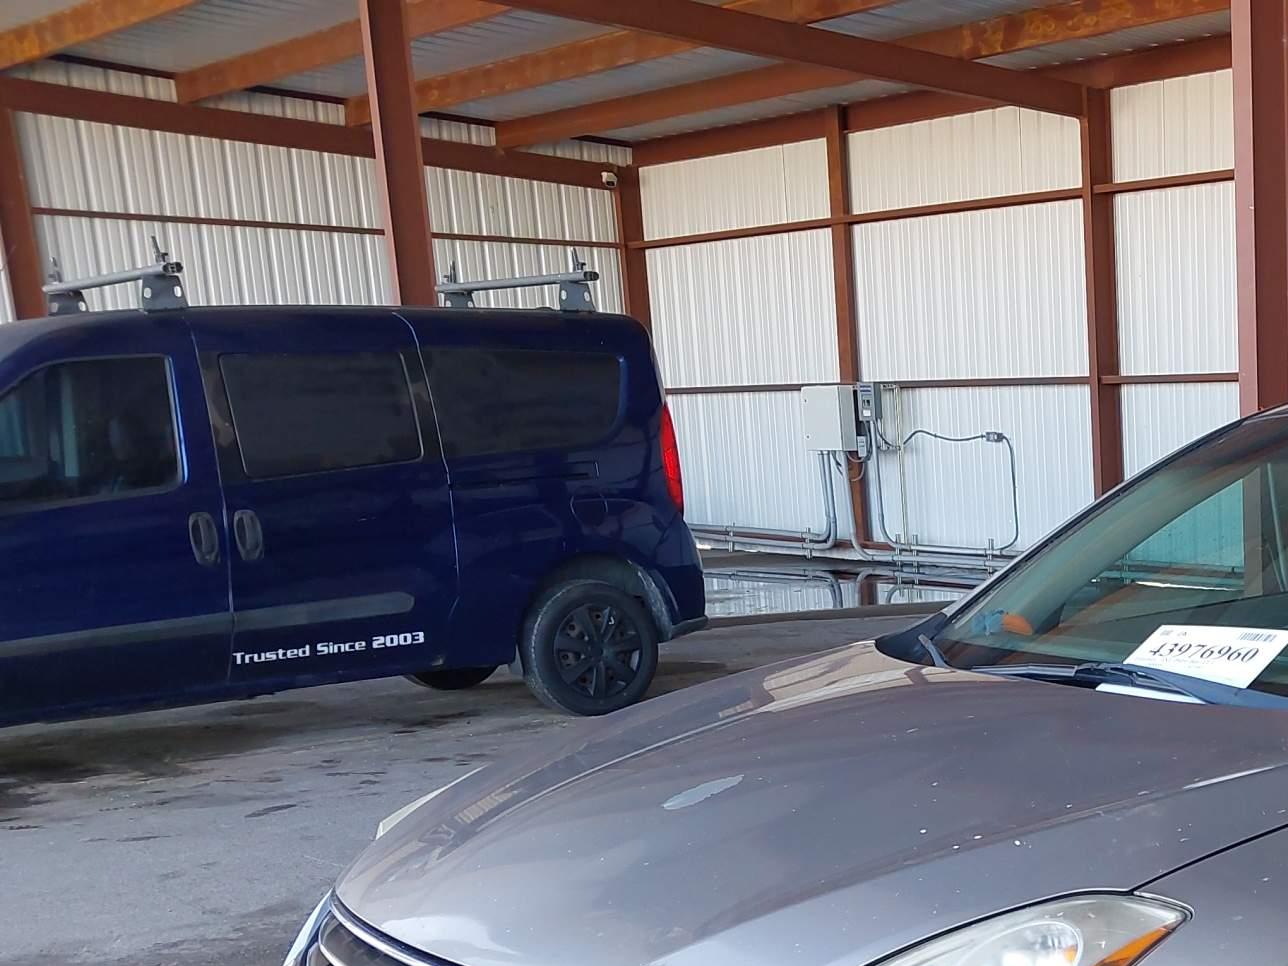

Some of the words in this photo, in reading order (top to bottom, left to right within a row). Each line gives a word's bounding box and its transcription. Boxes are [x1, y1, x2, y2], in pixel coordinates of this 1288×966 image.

[232, 644, 311, 665] Trusted
[316, 641, 367, 656] Since
[371, 631, 425, 649] 2003
[1149, 641, 1260, 664] 43976960
